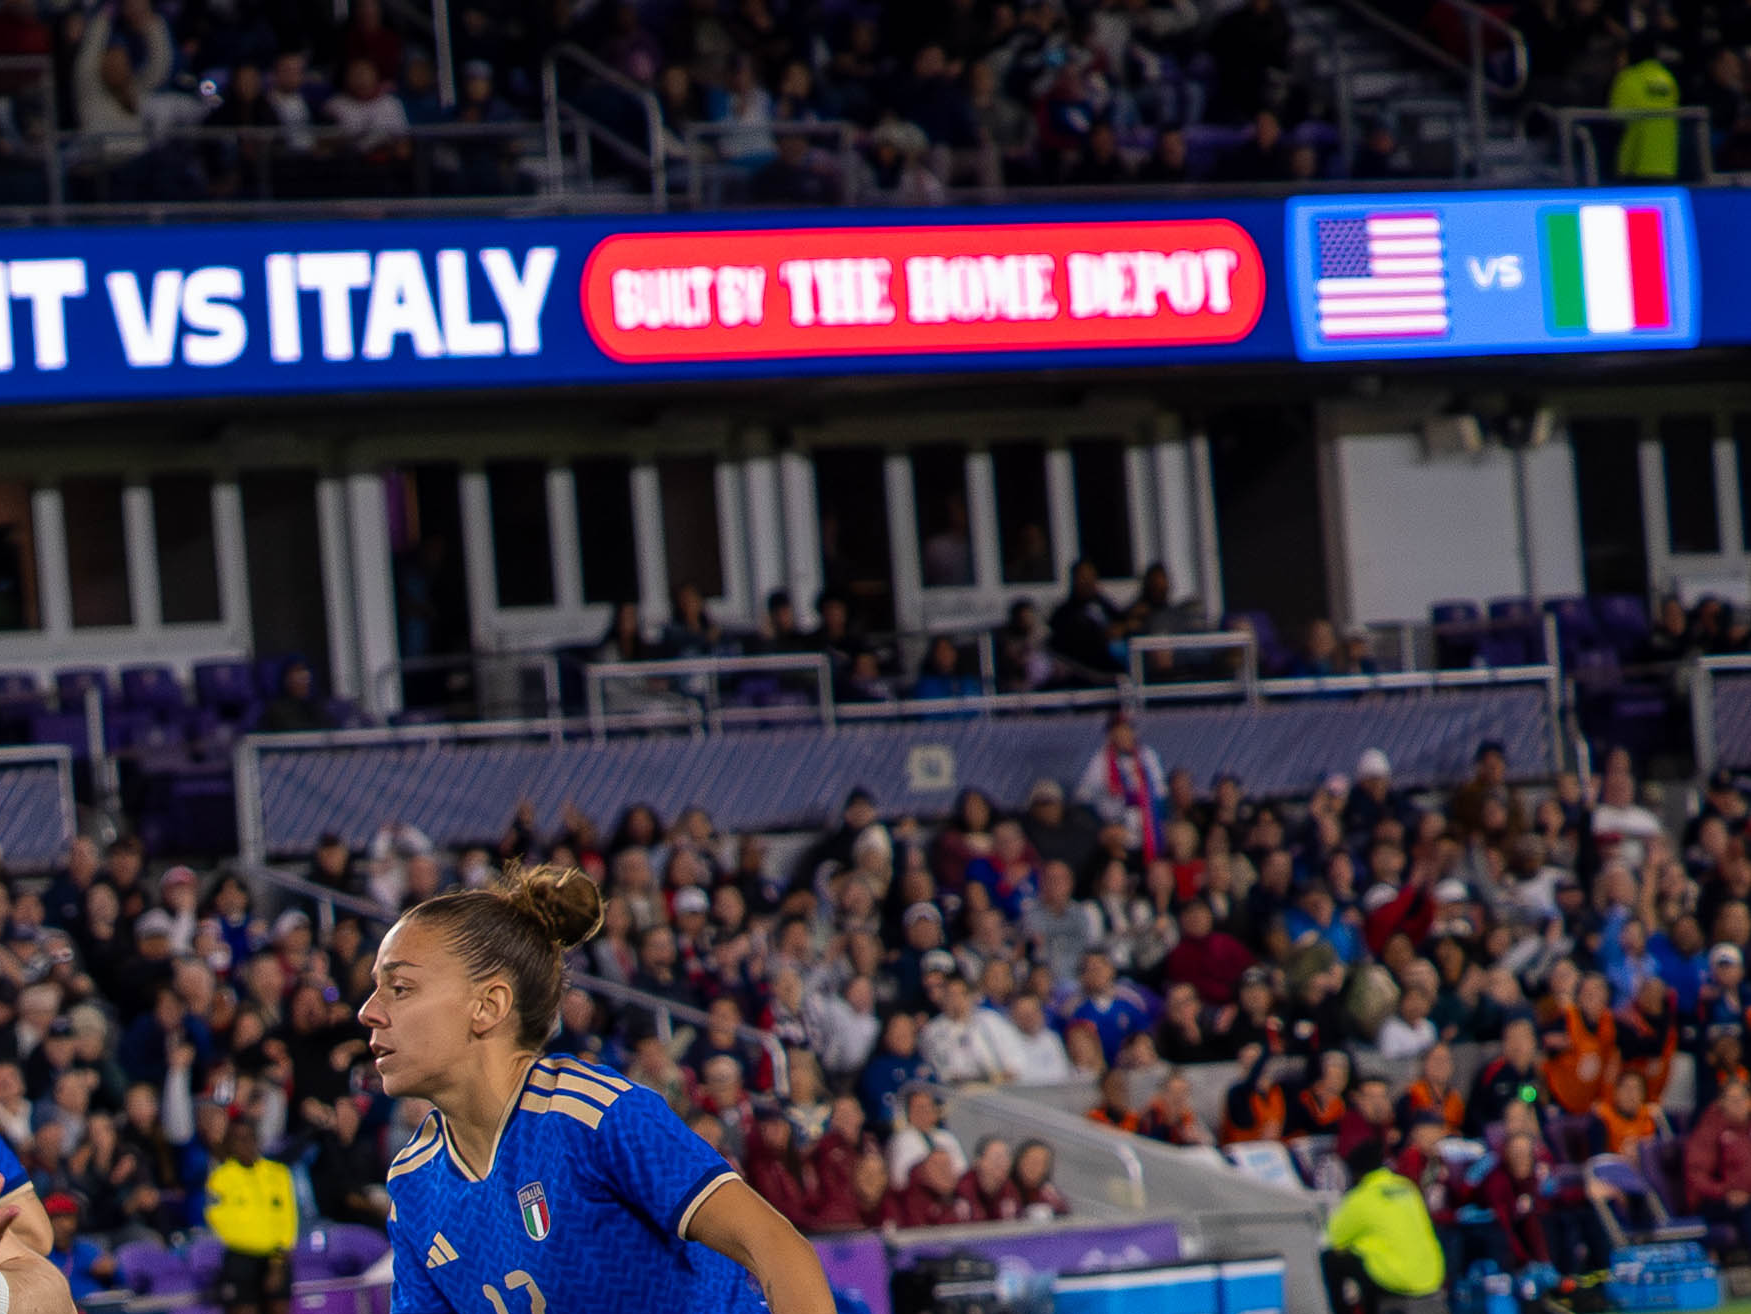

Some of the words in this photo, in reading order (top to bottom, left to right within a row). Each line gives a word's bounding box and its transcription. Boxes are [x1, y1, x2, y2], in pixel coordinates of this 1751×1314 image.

[265, 247, 557, 362] ITALY
[612, 266, 715, 329] BUILT
[779, 257, 896, 326] THE
[905, 254, 1059, 323] HOME
[1067, 249, 1237, 318] DEPOT
